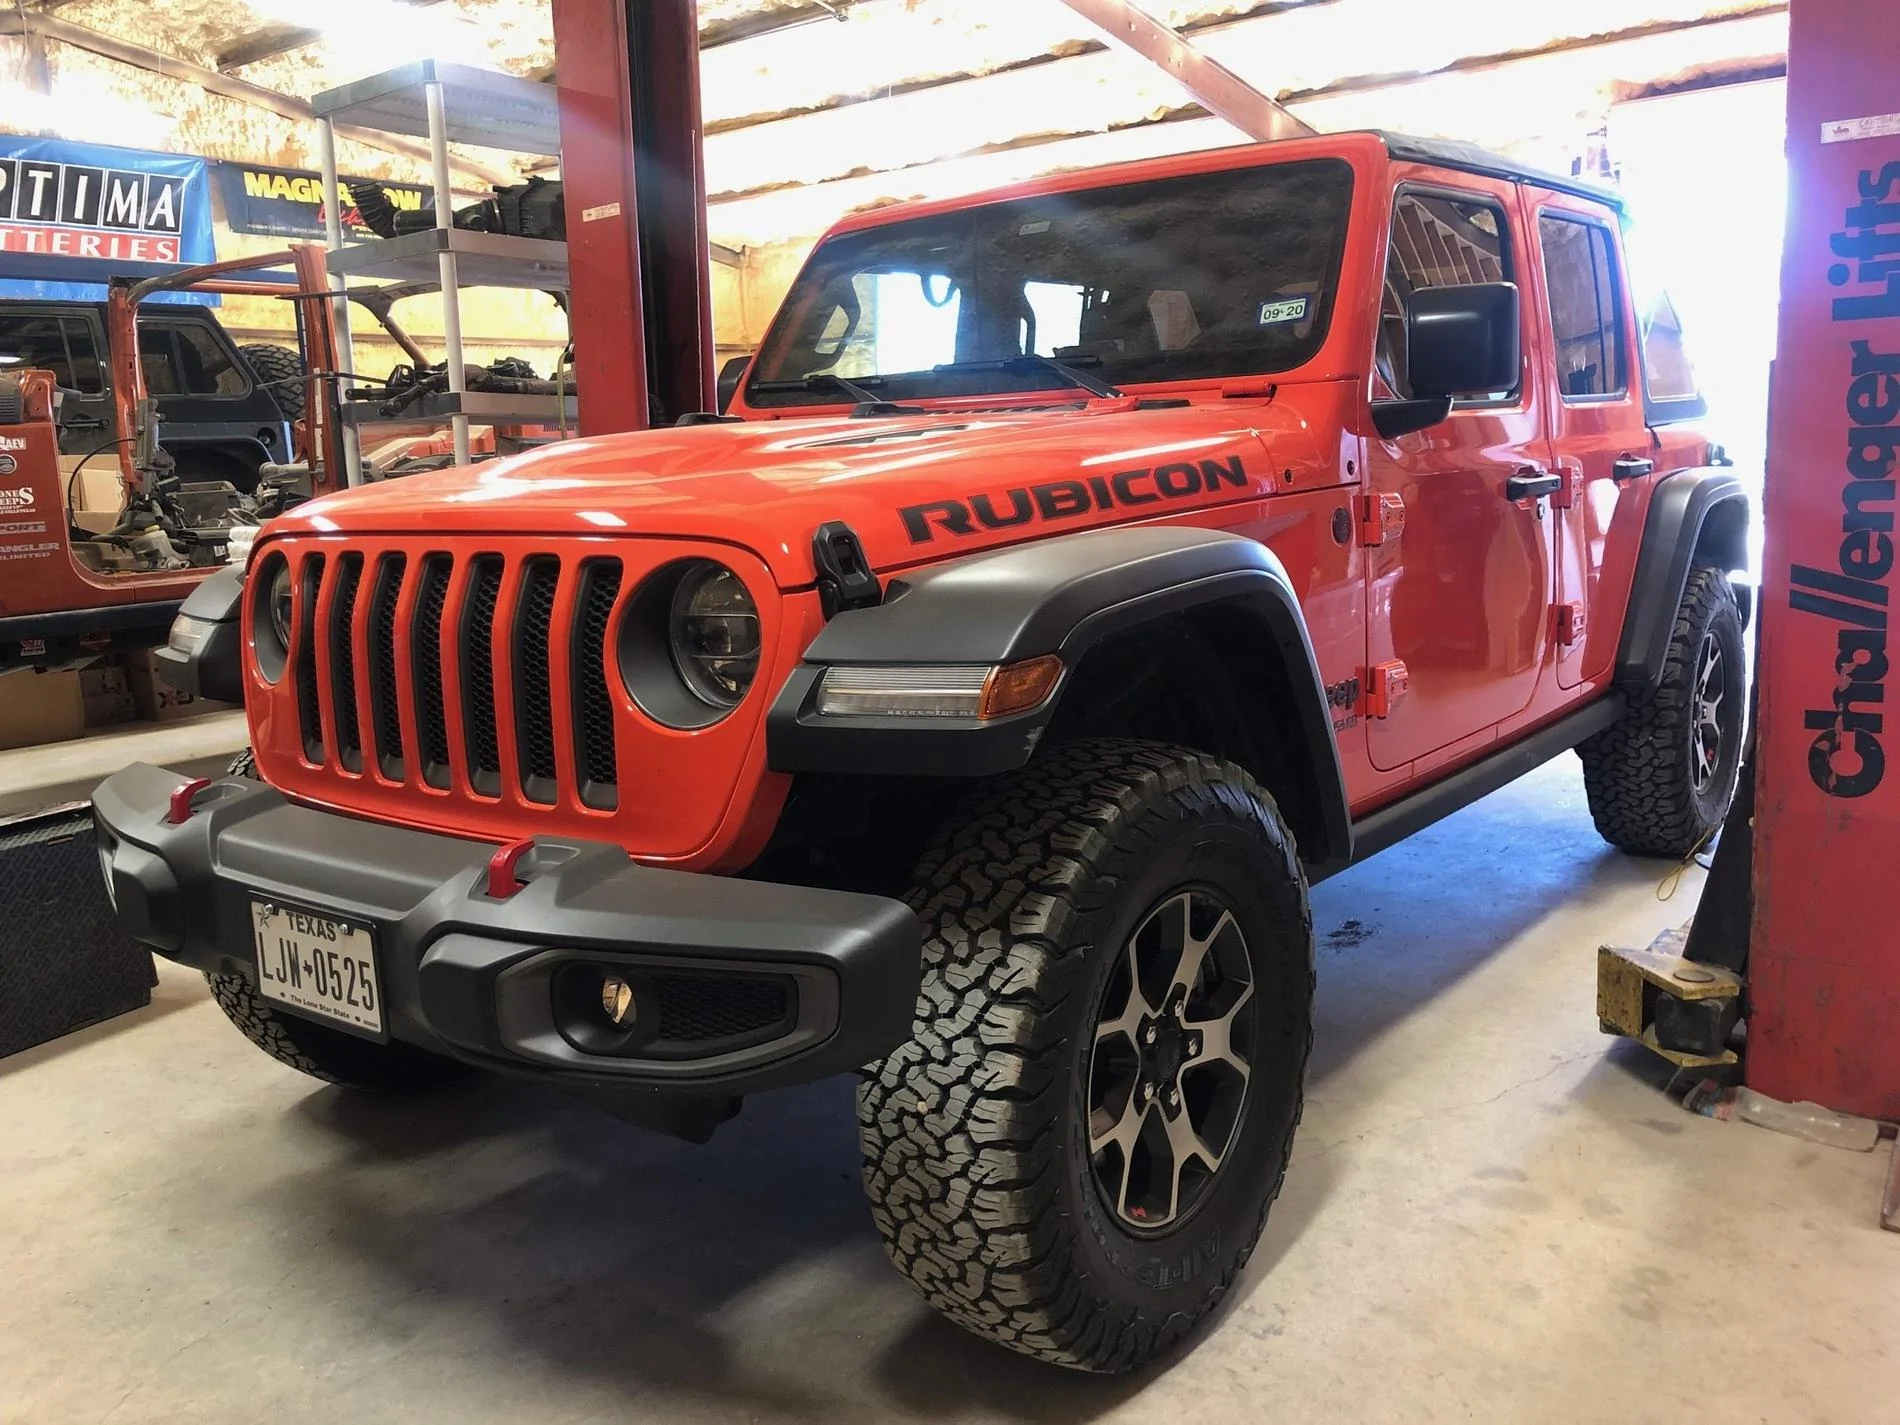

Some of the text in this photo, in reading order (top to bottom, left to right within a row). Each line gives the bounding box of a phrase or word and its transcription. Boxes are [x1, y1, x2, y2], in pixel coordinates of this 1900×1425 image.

[244, 171, 422, 211] MAGNAOW
[1828, 160, 1900, 322] Lifts
[1263, 304, 1303, 320] 09 20
[896, 454, 1249, 545] RUBICON
[0, 552, 51, 561] LIMITED
[1789, 338, 1900, 798] Challenger
[1324, 676, 1359, 710] eep
[285, 911, 337, 942] TEXAS
[303, 998, 318, 1009] Lone
[319, 1003, 332, 1013] Star
[333, 1008, 350, 1019] State
